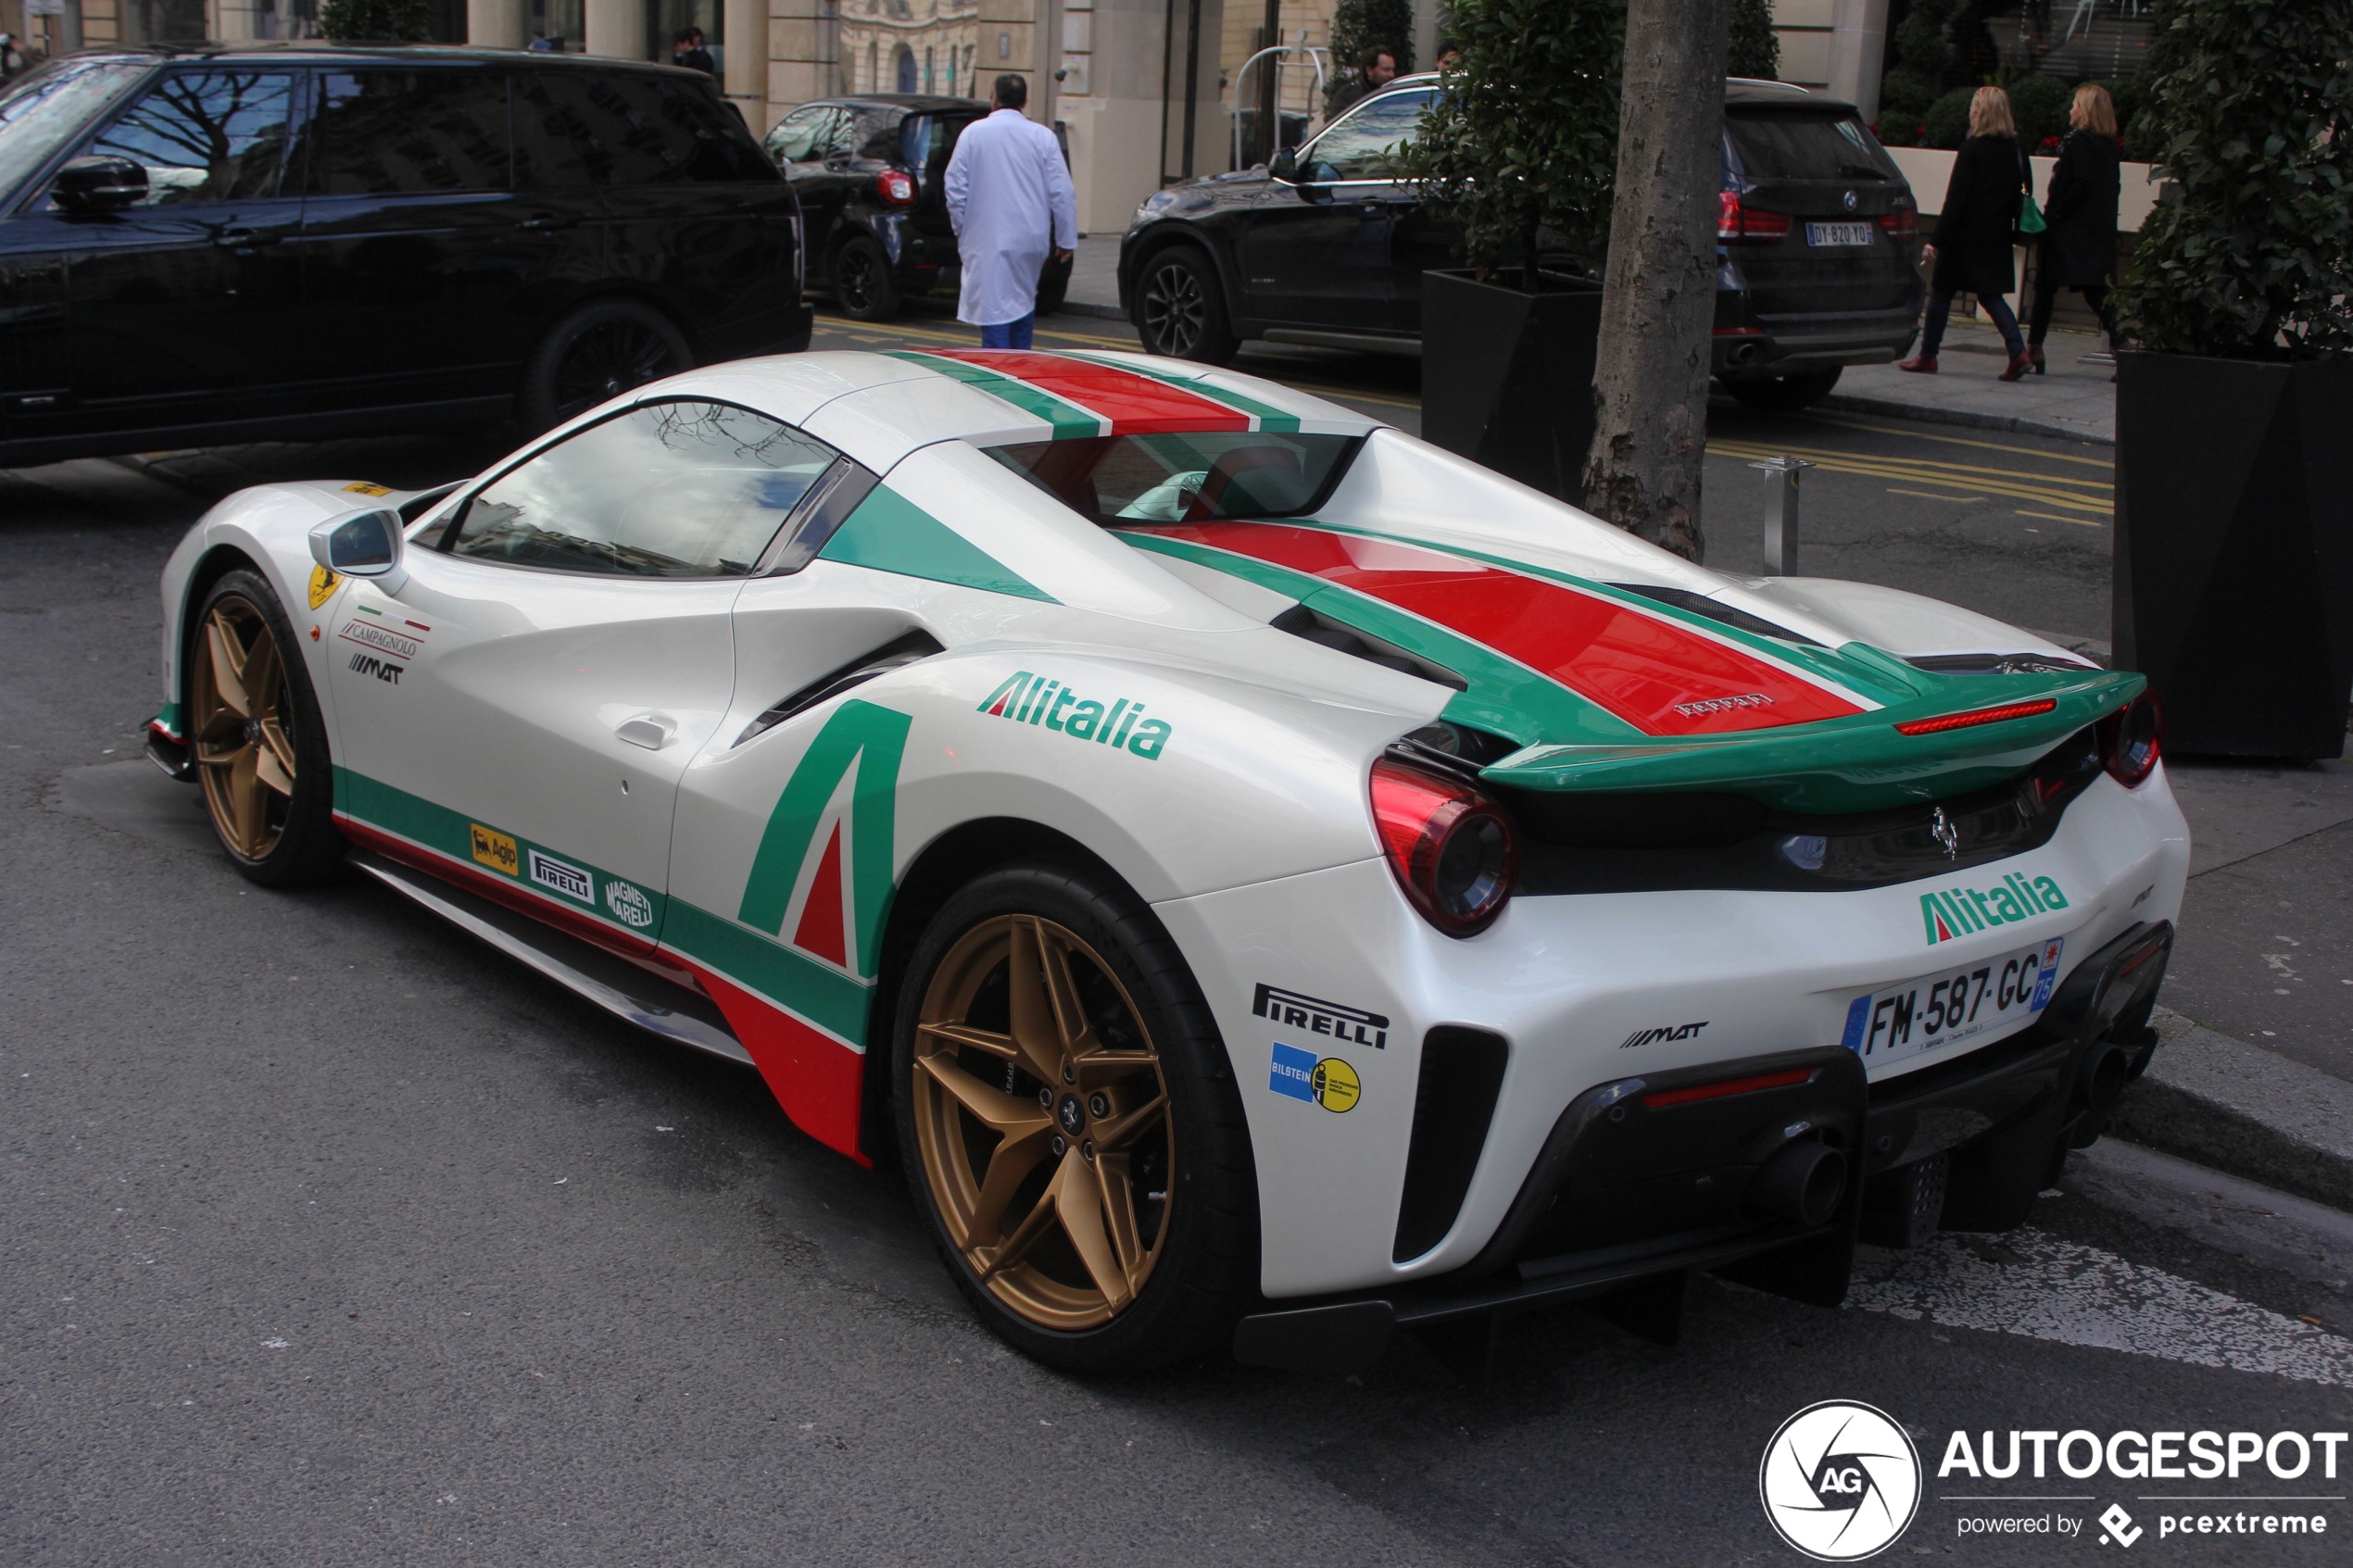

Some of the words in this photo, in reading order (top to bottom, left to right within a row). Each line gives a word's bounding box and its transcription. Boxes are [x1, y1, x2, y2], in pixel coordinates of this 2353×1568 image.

[352, 624, 416, 658] CAMPAGNOLO
[976, 671, 1172, 761] Alitalia
[1674, 693, 1775, 716] Ferrari
[492, 837, 517, 867] Agip
[534, 855, 589, 898] PIRELLI
[605, 881, 651, 910] MAGNETI
[607, 894, 653, 926] MARELLI
[1919, 872, 2070, 946] Alitalia
[1865, 953, 2039, 1056] FM-587-GC
[2033, 976, 2053, 1004] 75
[1252, 982, 1390, 1050] PIRELLI
[1271, 1061, 1312, 1084] BILSTEIN
